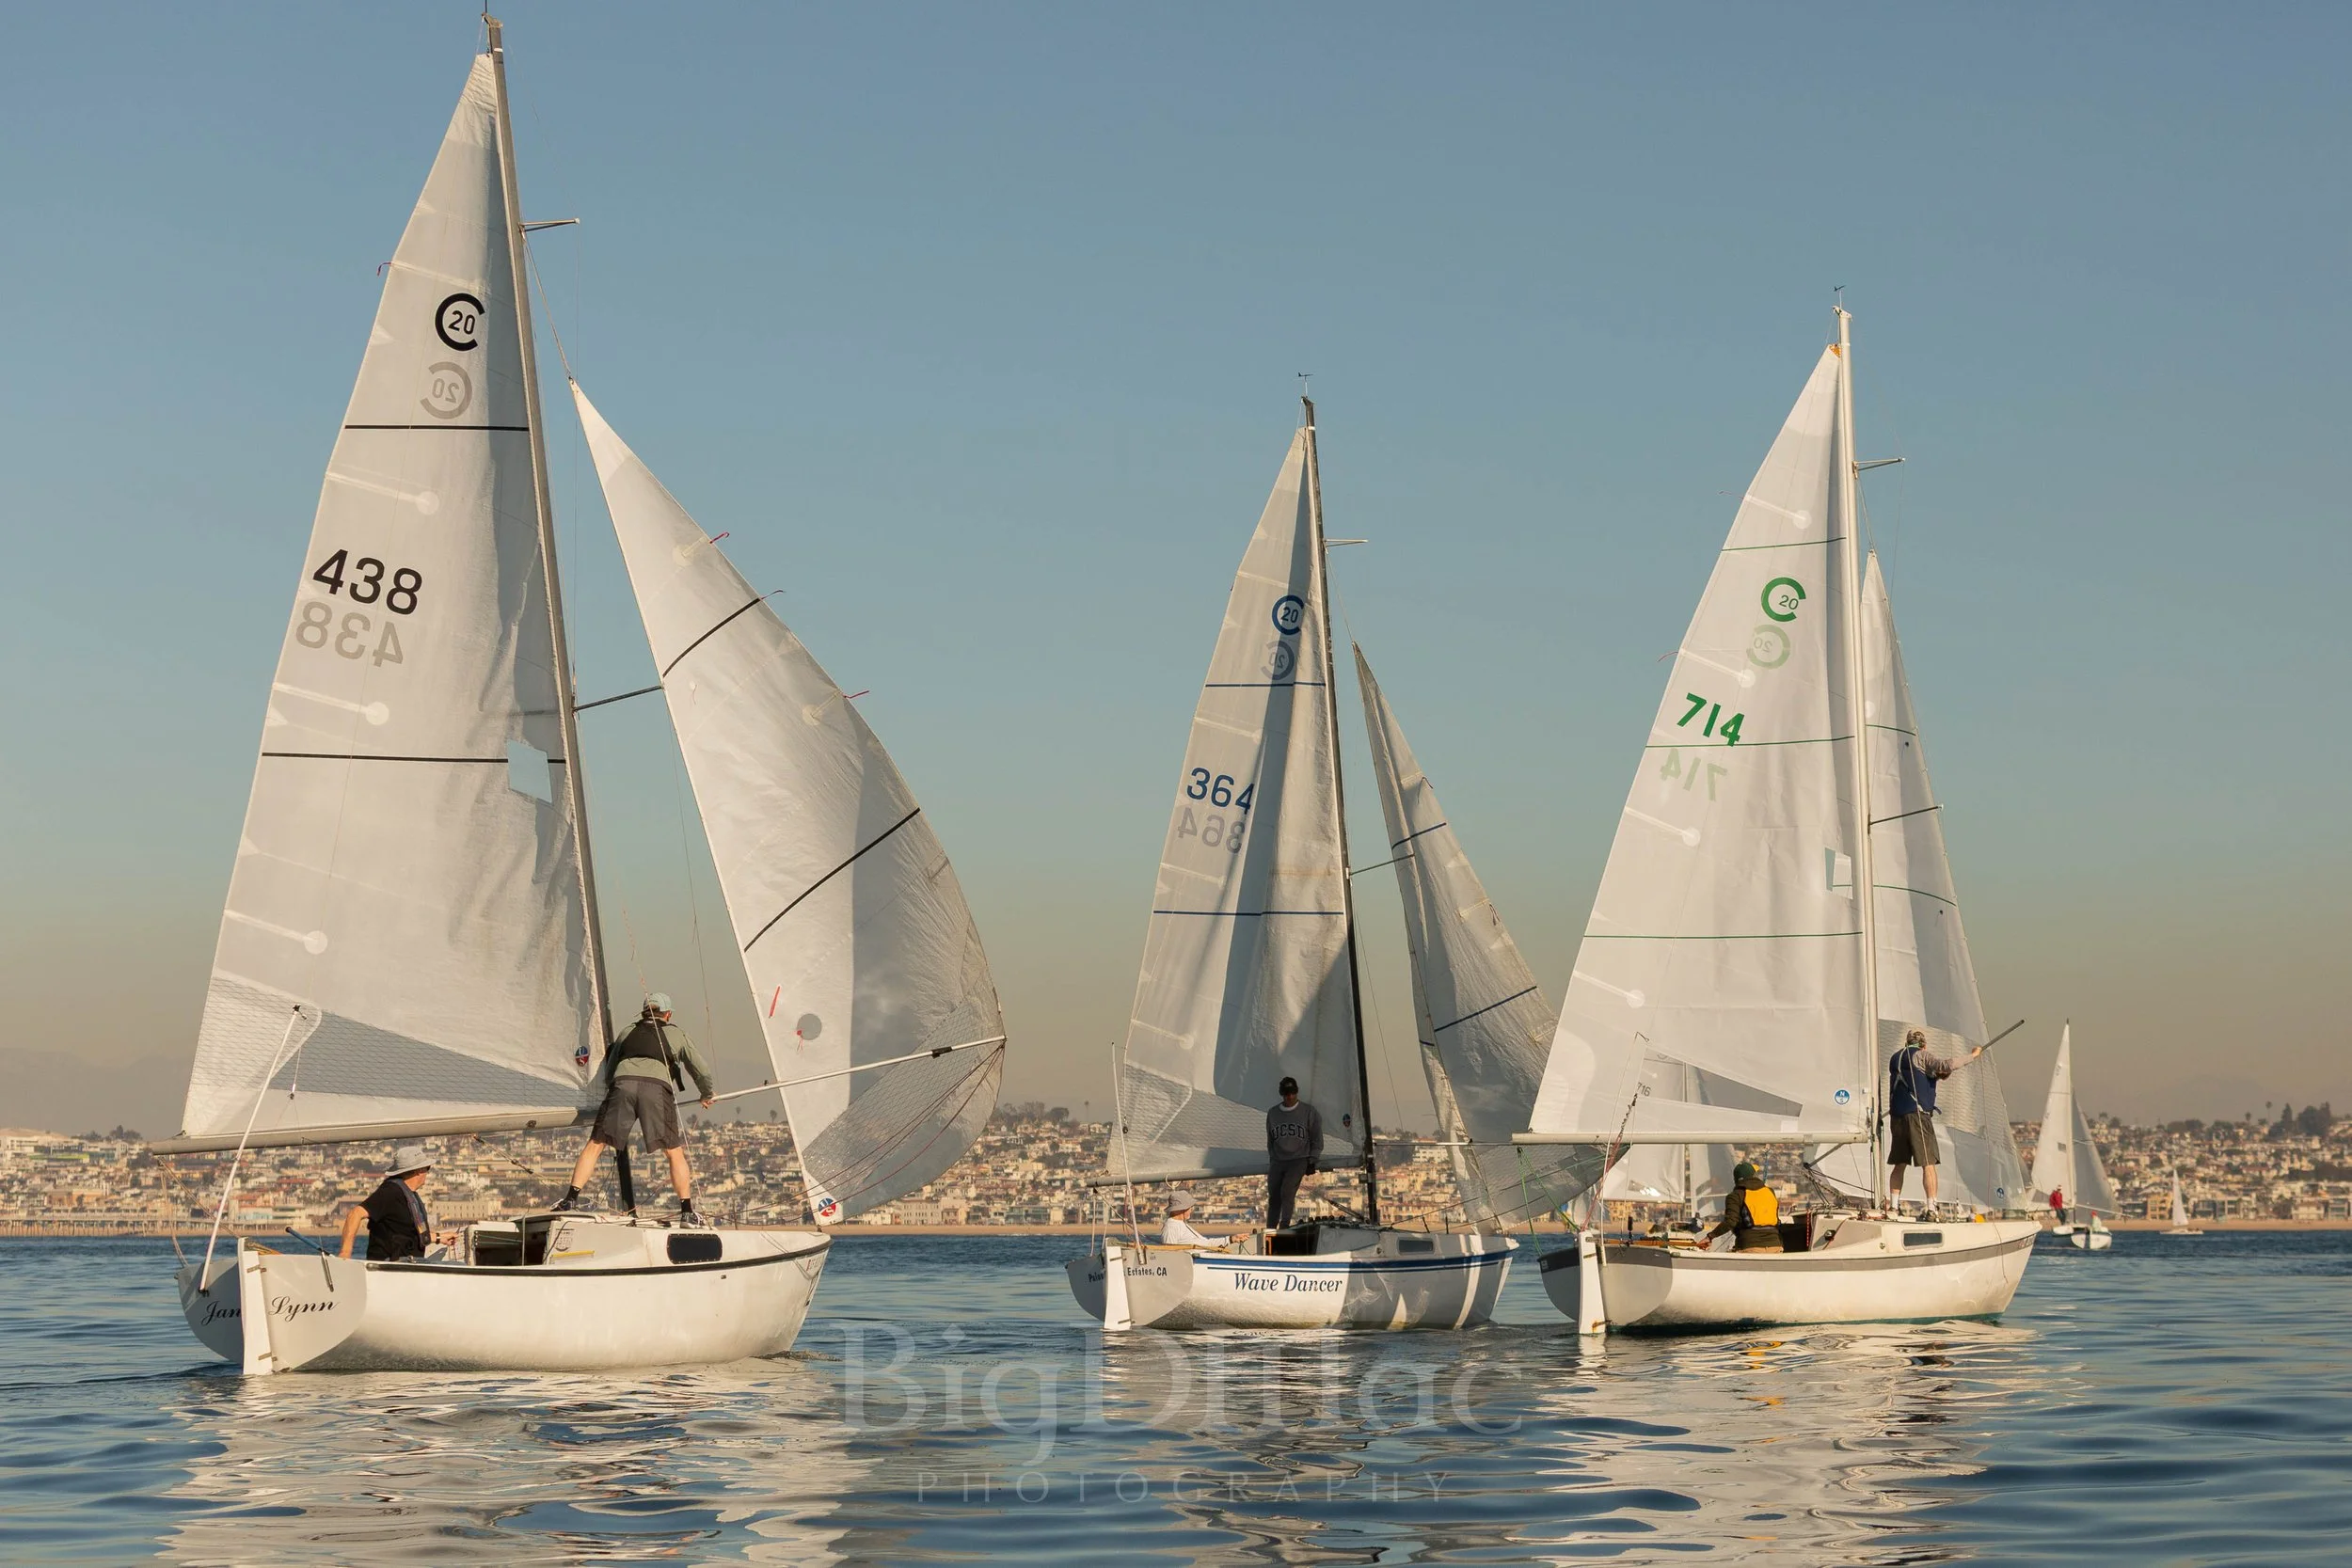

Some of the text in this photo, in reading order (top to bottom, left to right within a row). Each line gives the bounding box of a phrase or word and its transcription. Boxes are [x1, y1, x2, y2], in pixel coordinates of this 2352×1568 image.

[448, 309, 476, 335] 20
[312, 548, 423, 615] 438
[1778, 594, 1799, 610] 20
[1280, 606, 1298, 624] 20
[1677, 692, 1745, 747] 714
[1186, 768, 1255, 815] 364
[1637, 1082, 1651, 1097] 716
[1271, 1123, 1306, 1140] UCSD
[1156, 1266, 1168, 1276] CA
[1234, 1273, 1343, 1292] Wave Dancer
[268, 1295, 340, 1323] Lynn
